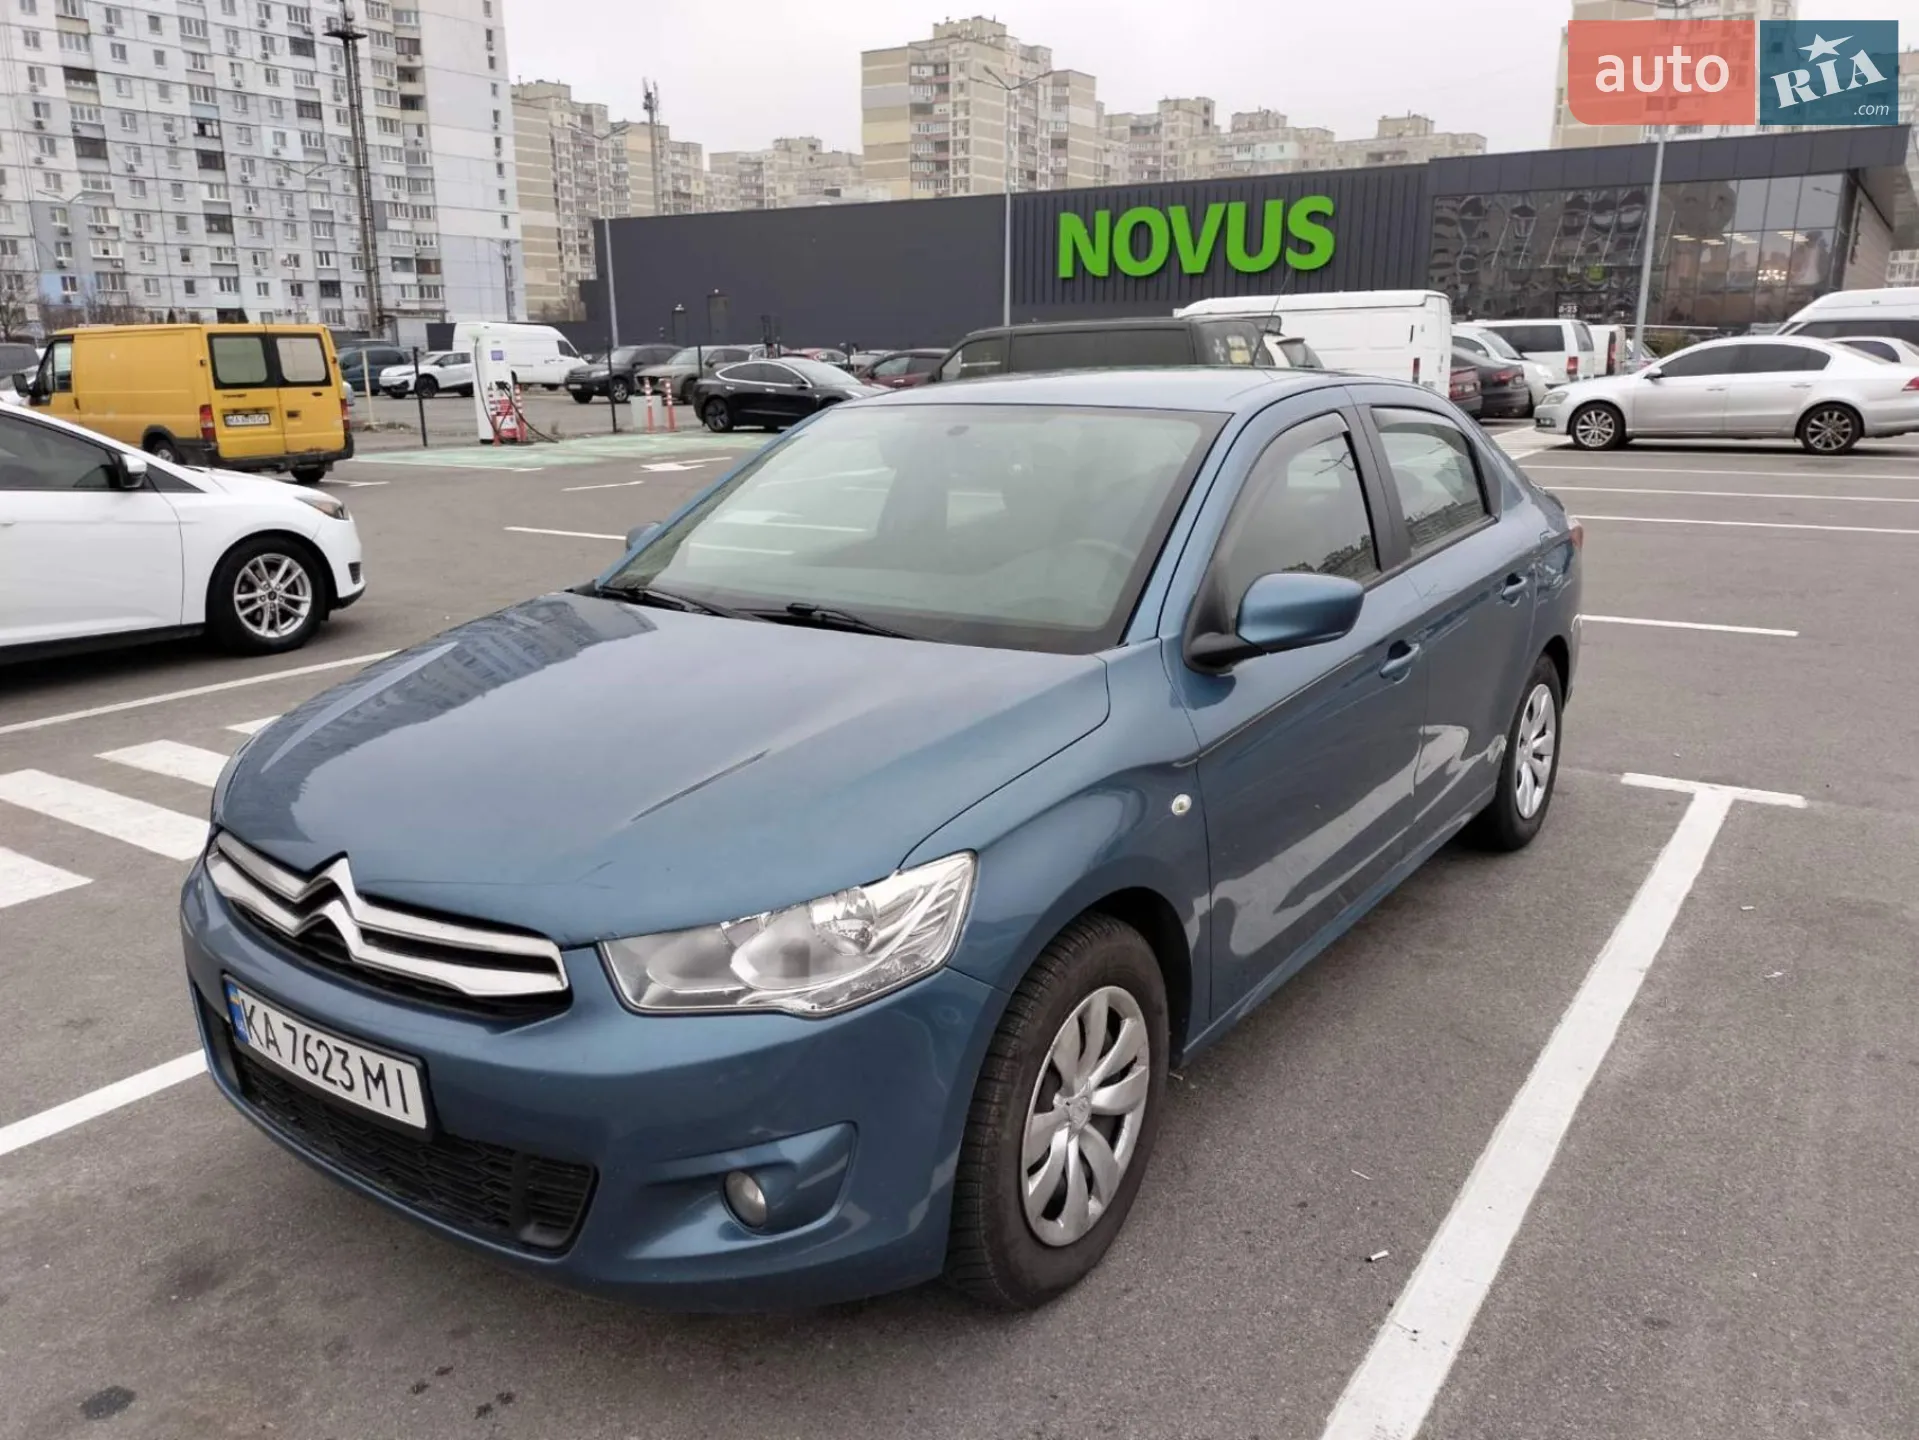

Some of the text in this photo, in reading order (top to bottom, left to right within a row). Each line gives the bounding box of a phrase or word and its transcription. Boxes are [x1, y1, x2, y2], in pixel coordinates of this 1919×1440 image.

[1058, 195, 1335, 278] NOVUS
[241, 998, 409, 1114] KA 7623 MI
